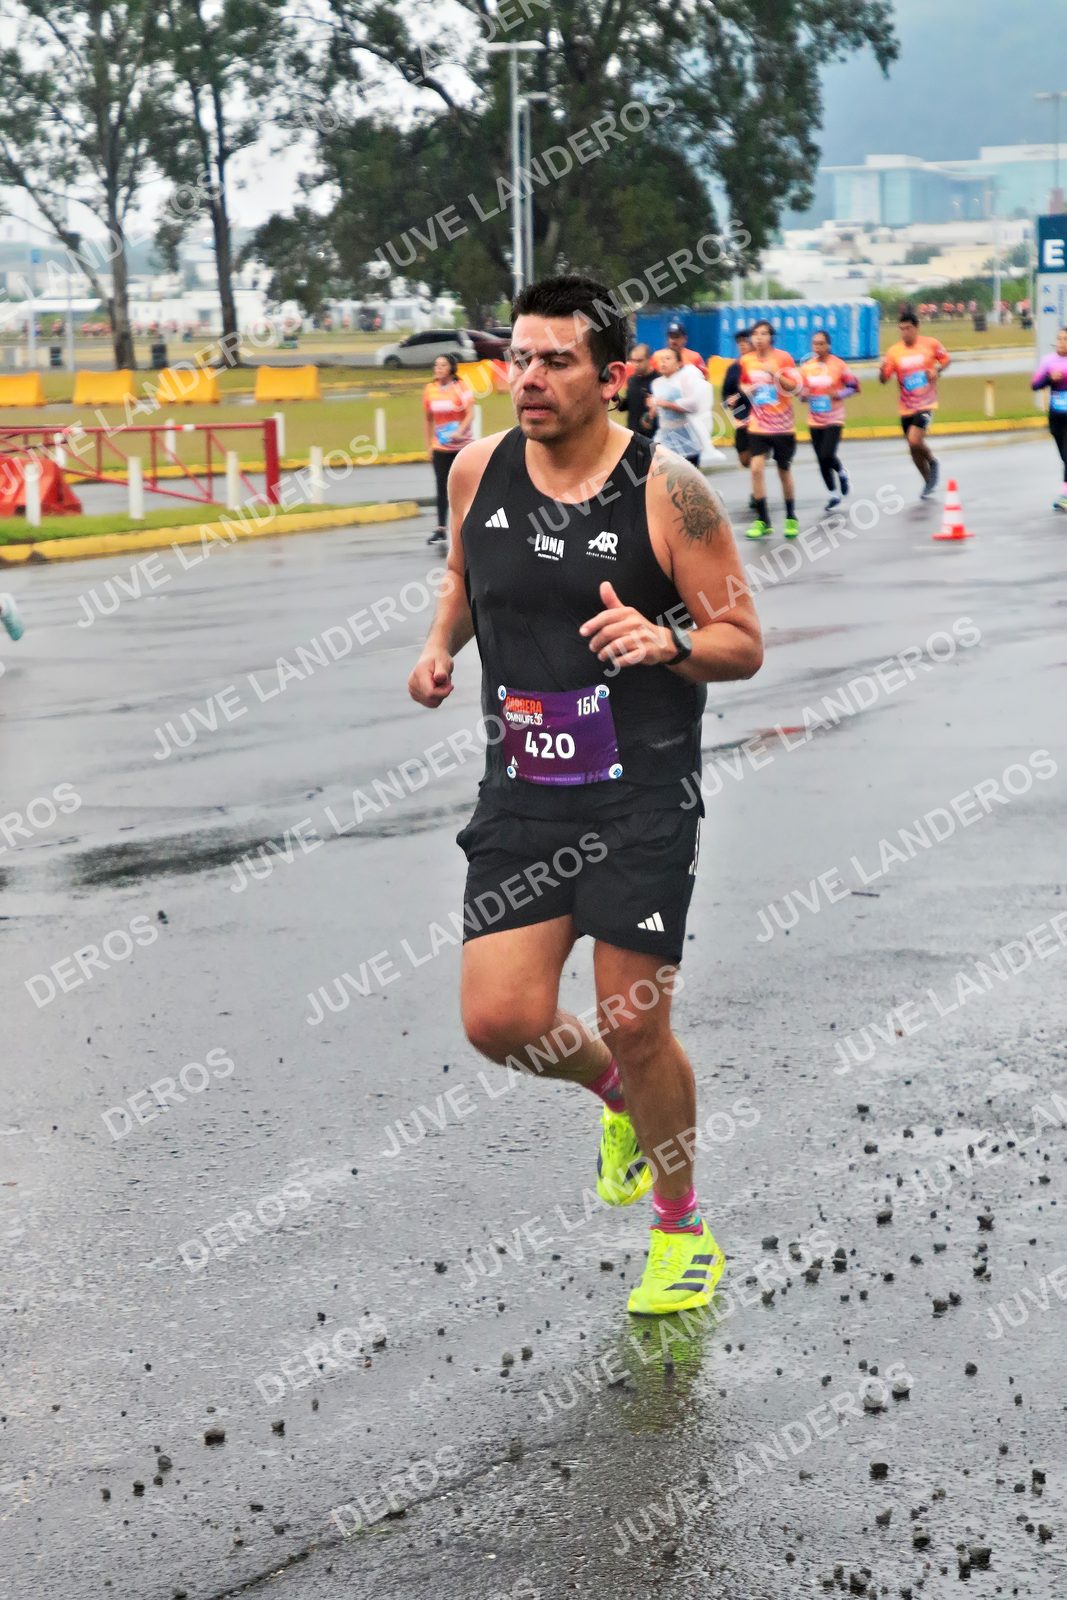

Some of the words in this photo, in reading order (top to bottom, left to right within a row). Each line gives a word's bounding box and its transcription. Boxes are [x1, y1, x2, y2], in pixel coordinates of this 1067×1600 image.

[1043, 239, 1065, 267] E
[535, 534, 565, 558] LUNA
[577, 695, 600, 717] 15K
[525, 731, 576, 759] 420
